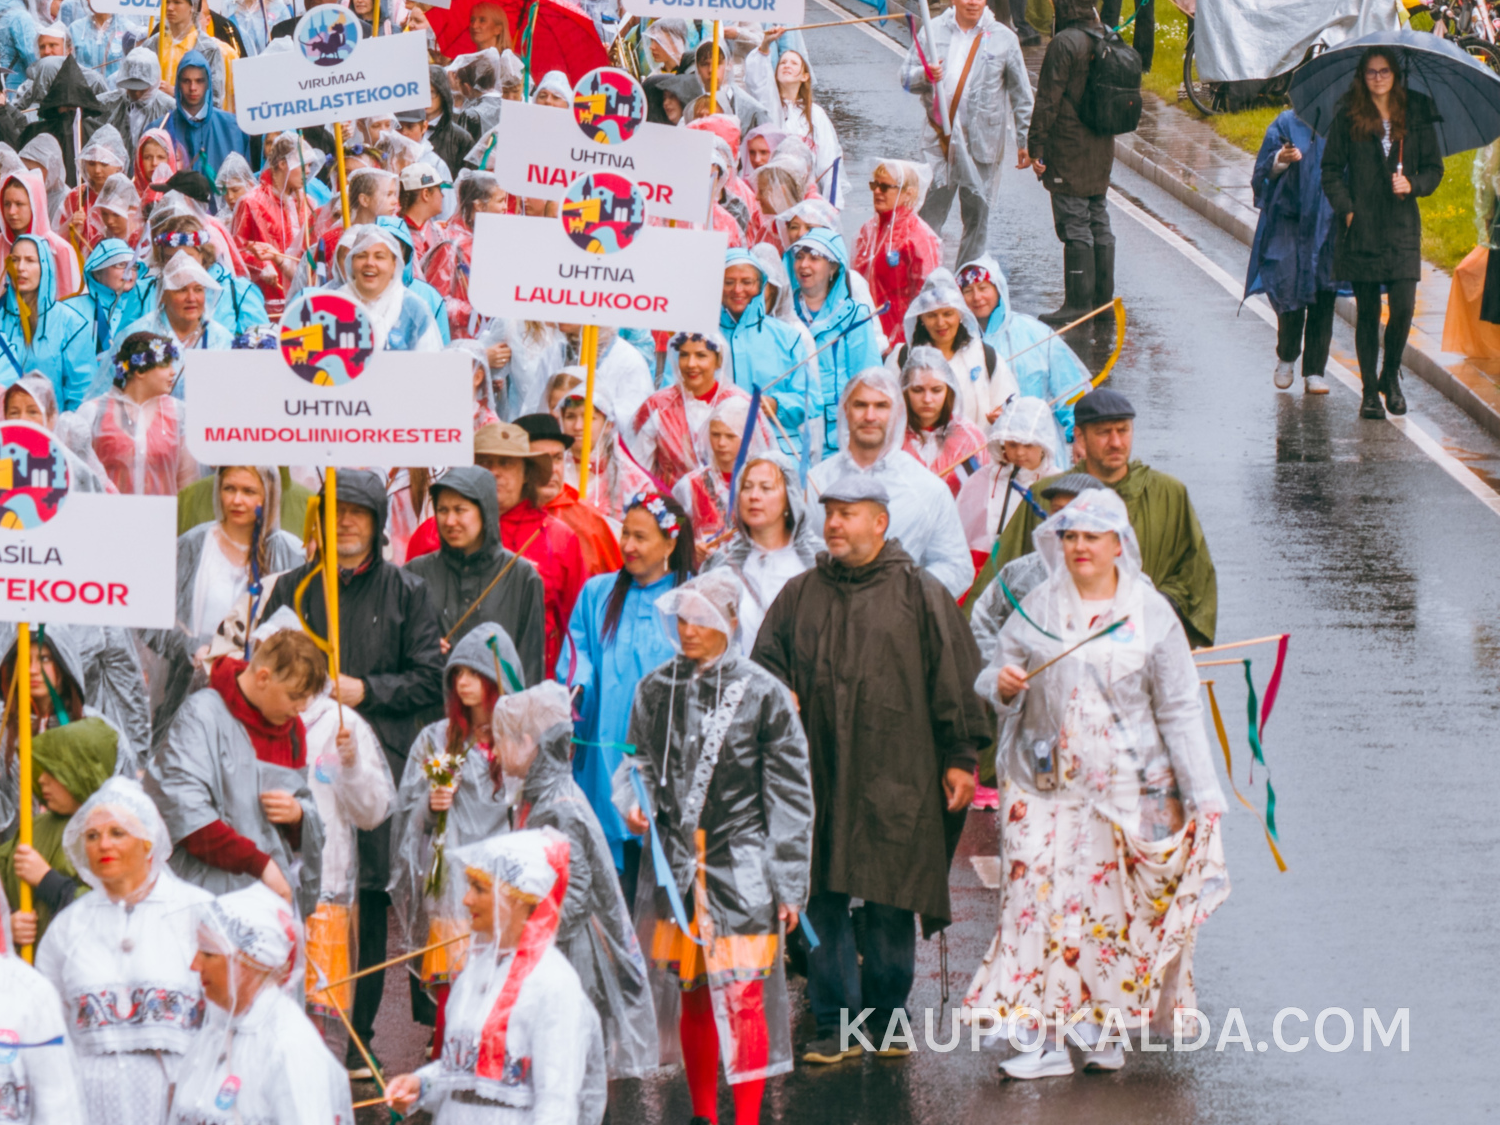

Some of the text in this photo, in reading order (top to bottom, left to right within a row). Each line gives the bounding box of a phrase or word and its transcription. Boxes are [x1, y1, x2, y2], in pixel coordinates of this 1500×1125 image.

[308, 70, 376, 90] VIRUMAA
[246, 81, 420, 122] TÜTARLASTEKOOR
[570, 147, 636, 170] UHTNA
[526, 163, 675, 205] NAIOR
[558, 263, 636, 283] UHTNA
[513, 285, 669, 313] LAULUKOOR
[284, 400, 372, 417] UHTNA
[204, 427, 463, 444] MANDOLIINIORKESTER
